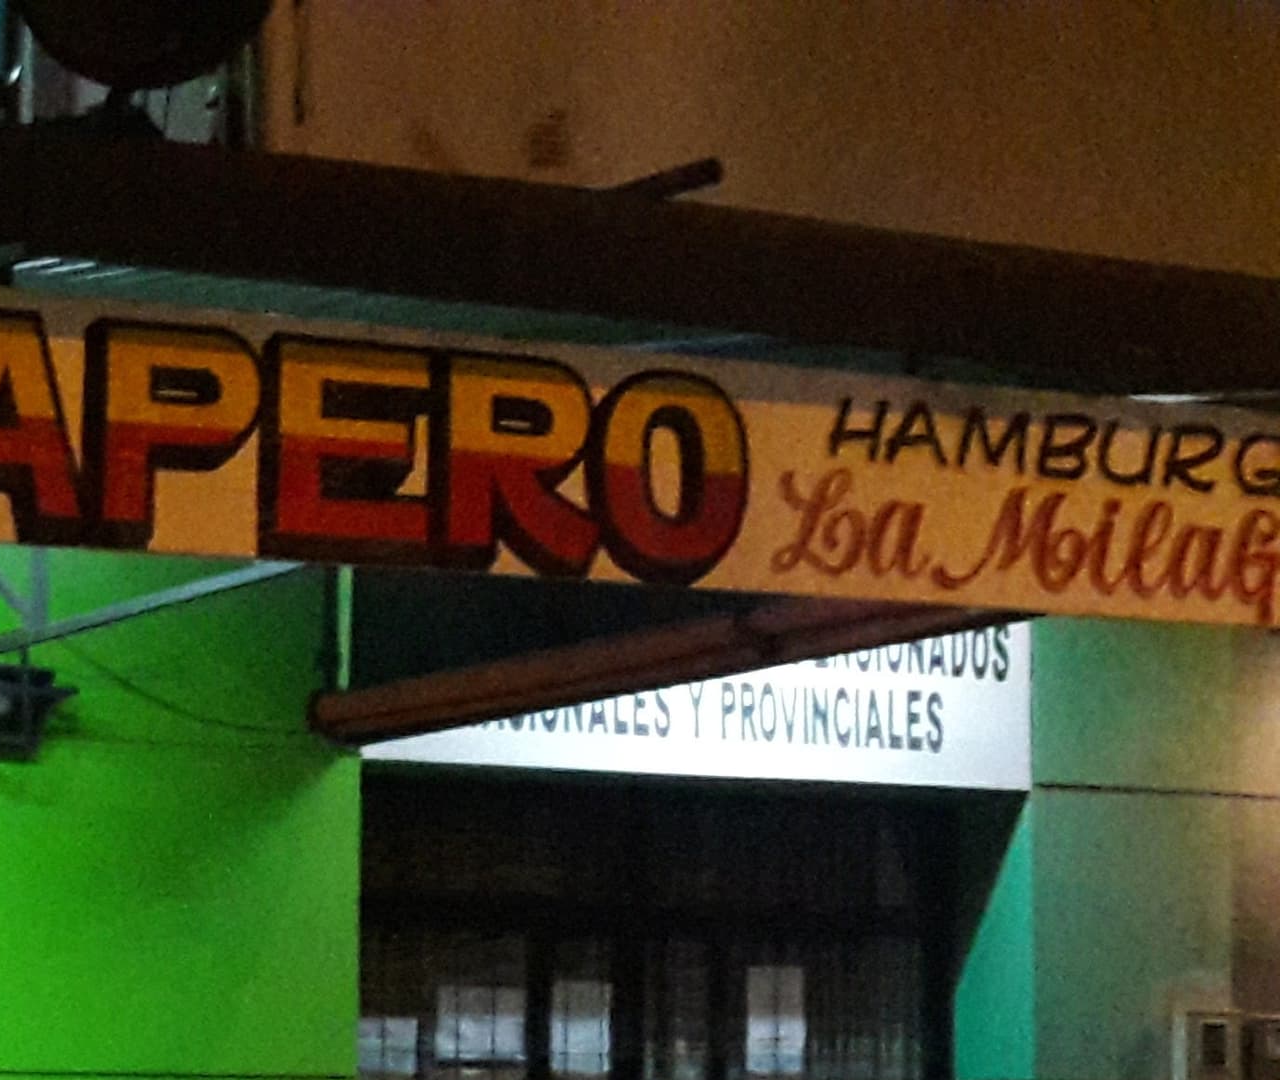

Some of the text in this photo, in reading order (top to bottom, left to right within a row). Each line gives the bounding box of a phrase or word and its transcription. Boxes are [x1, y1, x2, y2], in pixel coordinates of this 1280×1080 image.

[829, 398, 1280, 496] HAMBURG
[770, 467, 930, 578] La
[689, 681, 704, 739] Y
[721, 681, 944, 753] PROVINCIALES
